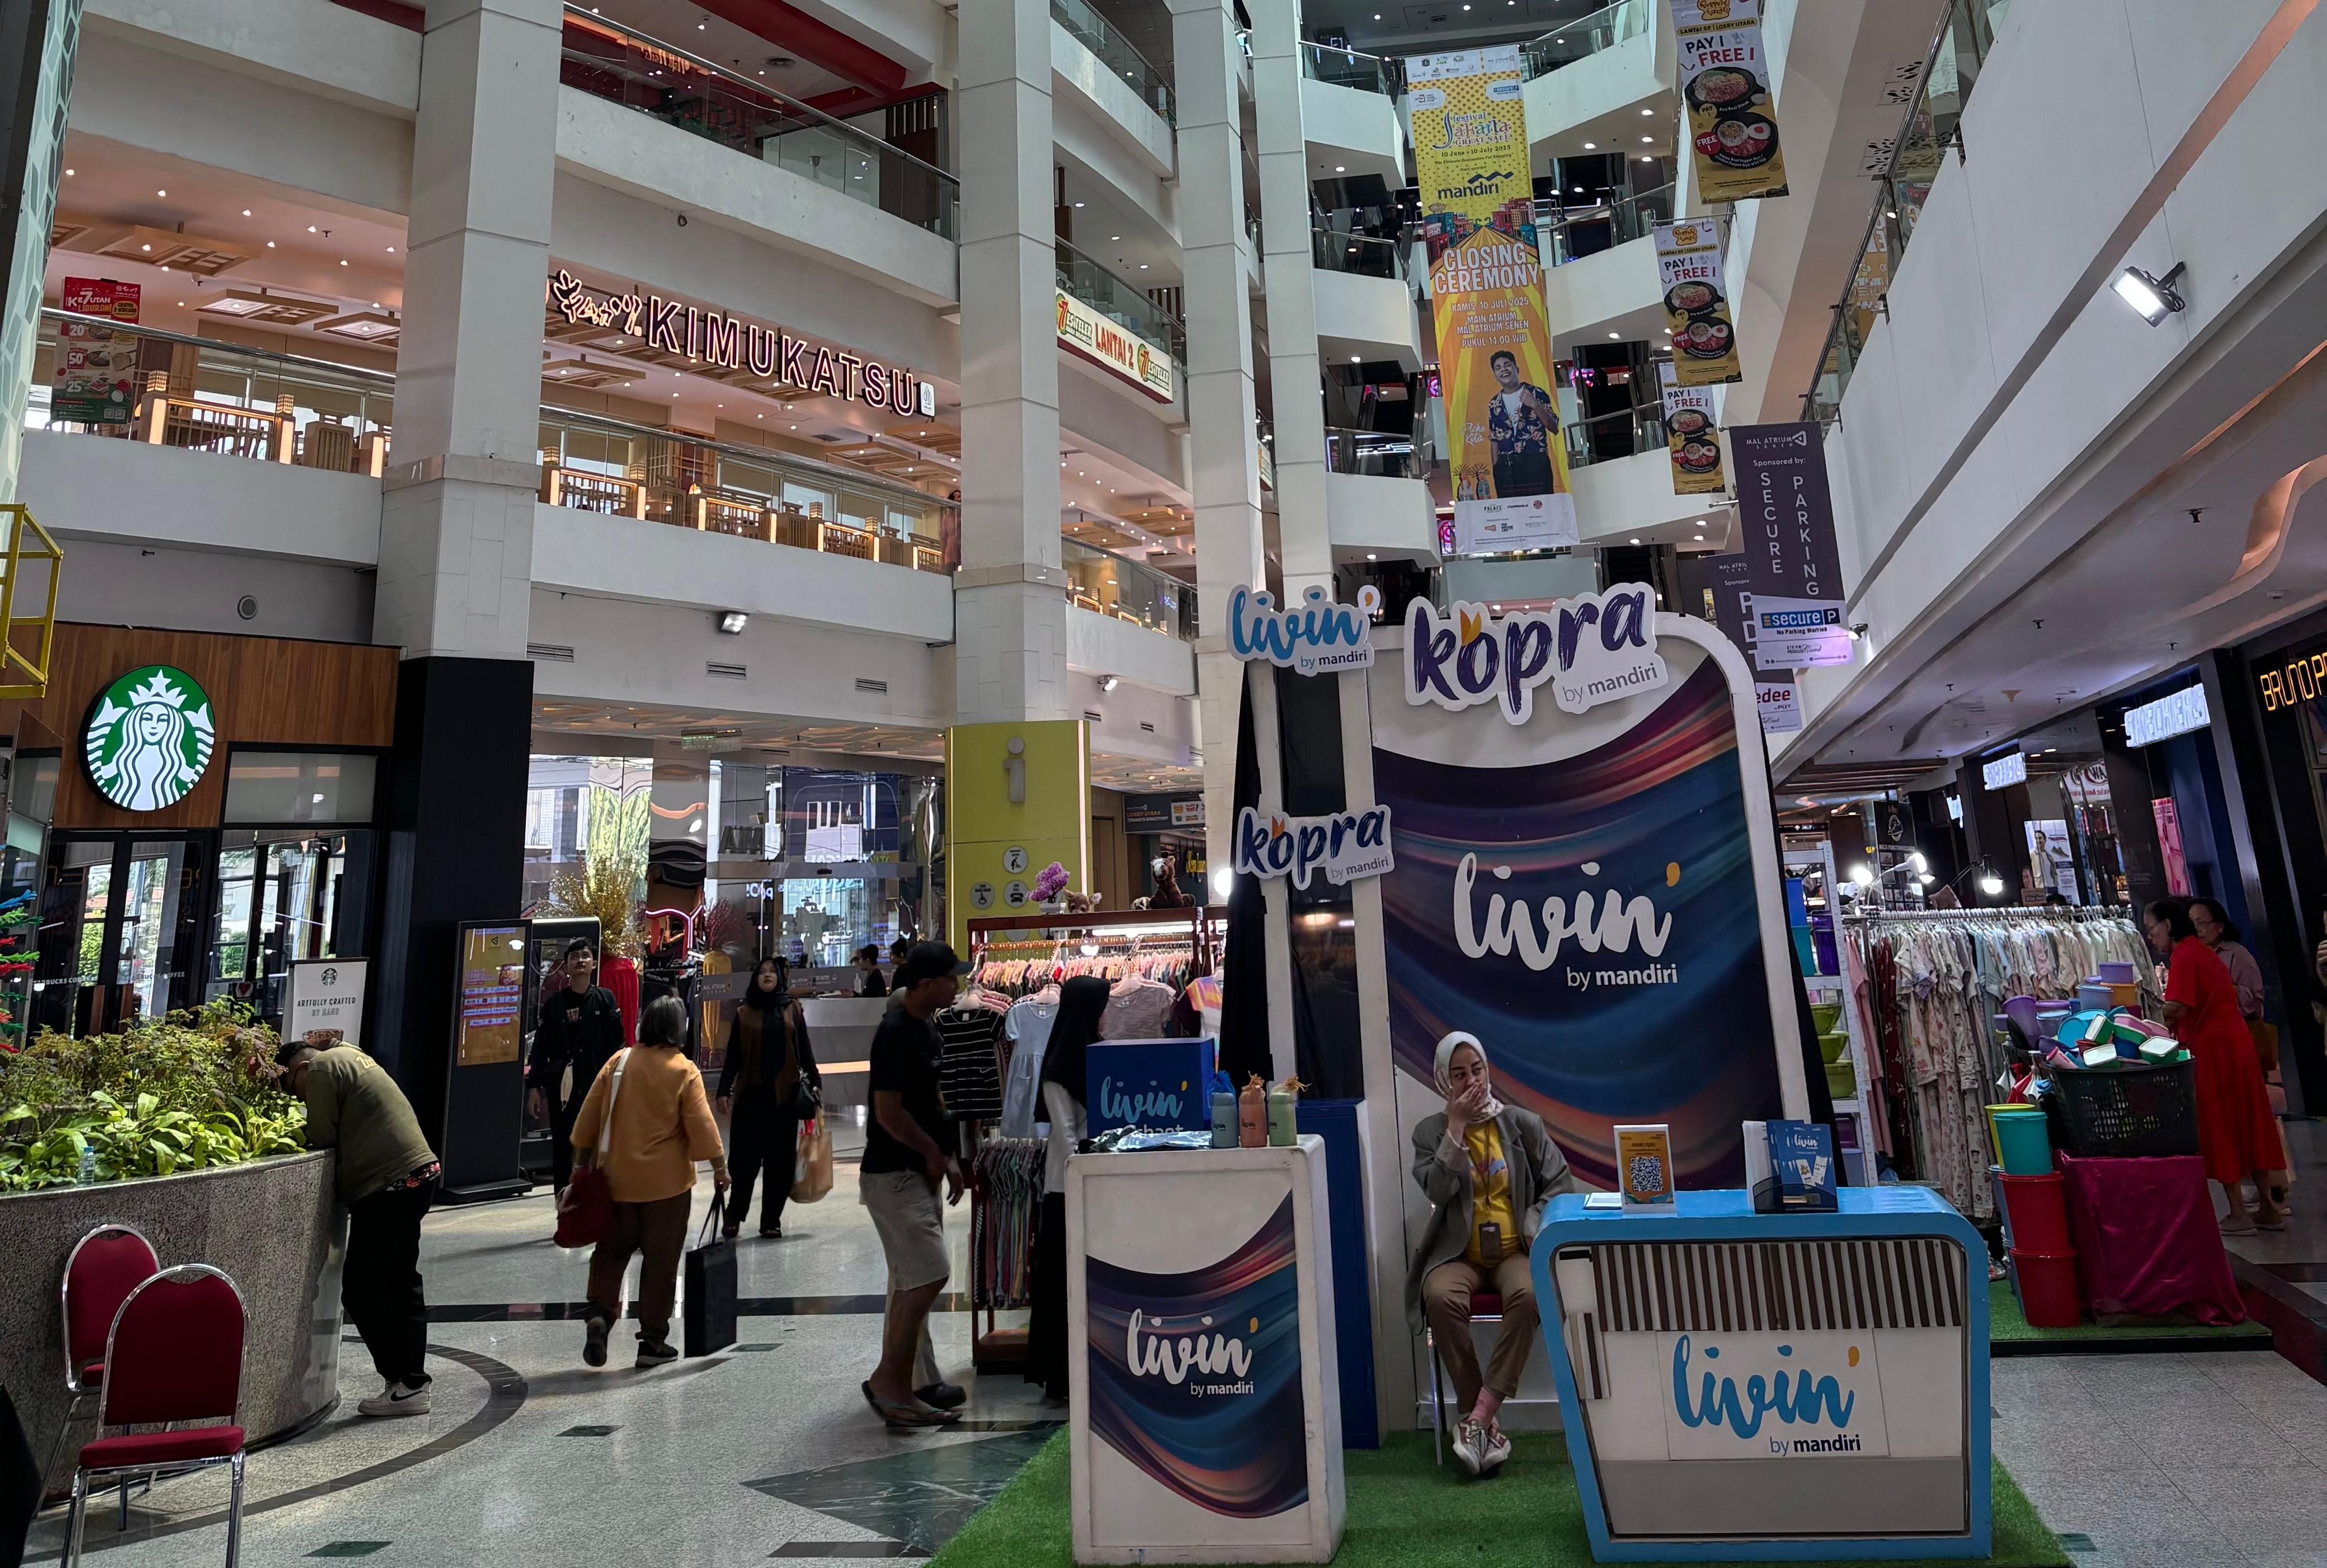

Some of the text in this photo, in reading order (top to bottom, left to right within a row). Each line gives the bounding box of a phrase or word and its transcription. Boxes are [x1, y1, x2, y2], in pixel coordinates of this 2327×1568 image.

[1685, 36, 1714, 54] PAY
[1698, 48, 1744, 67] FREE
[1453, 112, 1485, 123] festival
[1697, 135, 1717, 147] FREE
[1438, 181, 1499, 199] mandiri
[1443, 243, 1527, 271] CLOSING
[1665, 258, 1685, 271] PAY
[1435, 263, 1538, 294] CEREMONY
[1674, 267, 1708, 280] FREE
[1491, 299, 1507, 308] JULI
[1510, 298, 1529, 307] 2025
[1075, 317, 1092, 336] TELER
[1467, 312, 1516, 324] MAIN ATRIUM
[69, 325, 84, 336] 20
[1457, 321, 1528, 334] MAL ATRIUM SENEN
[1095, 322, 1126, 365] LANTAI
[1128, 343, 1134, 369] 2
[1462, 334, 1527, 347] PUKUL 14.00 WIB
[1674, 333, 1689, 342] FREE
[68, 354, 83, 364] 50
[646, 295, 914, 417] KIMUKATSU
[1155, 365, 1170, 383] TELER
[68, 380, 82, 392] 25
[1667, 390, 1684, 399] PAY
[1675, 398, 1702, 408] FREE
[1764, 436, 1792, 445] ATRIUM
[1753, 457, 1806, 467] Sponsored by:
[1760, 472, 1783, 573] SECURE
[1793, 476, 1819, 595] PARKING
[1232, 588, 1374, 661] livin'
[1773, 610, 1836, 626] secure P
[1301, 649, 1368, 670] by mandiri
[1414, 591, 1647, 715] kopra
[1563, 662, 1658, 704] by mandiri
[2260, 660, 2314, 711] BRUNO
[1756, 688, 1791, 704] edee
[1240, 811, 1384, 889] kopra
[1330, 856, 1389, 879] by mandiri
[1454, 853, 1680, 971] livin'
[1566, 963, 1678, 991] by mandiri
[297, 997, 356, 1007] ARTFULLY CRAFTED
[1101, 1076, 1187, 1123] livin'
[1127, 1308, 1258, 1384] livin'
[1190, 1381, 1254, 1397] by mandiri
[1673, 1335, 1859, 1439] livin'
[1770, 1434, 1861, 1457] by mandiri
